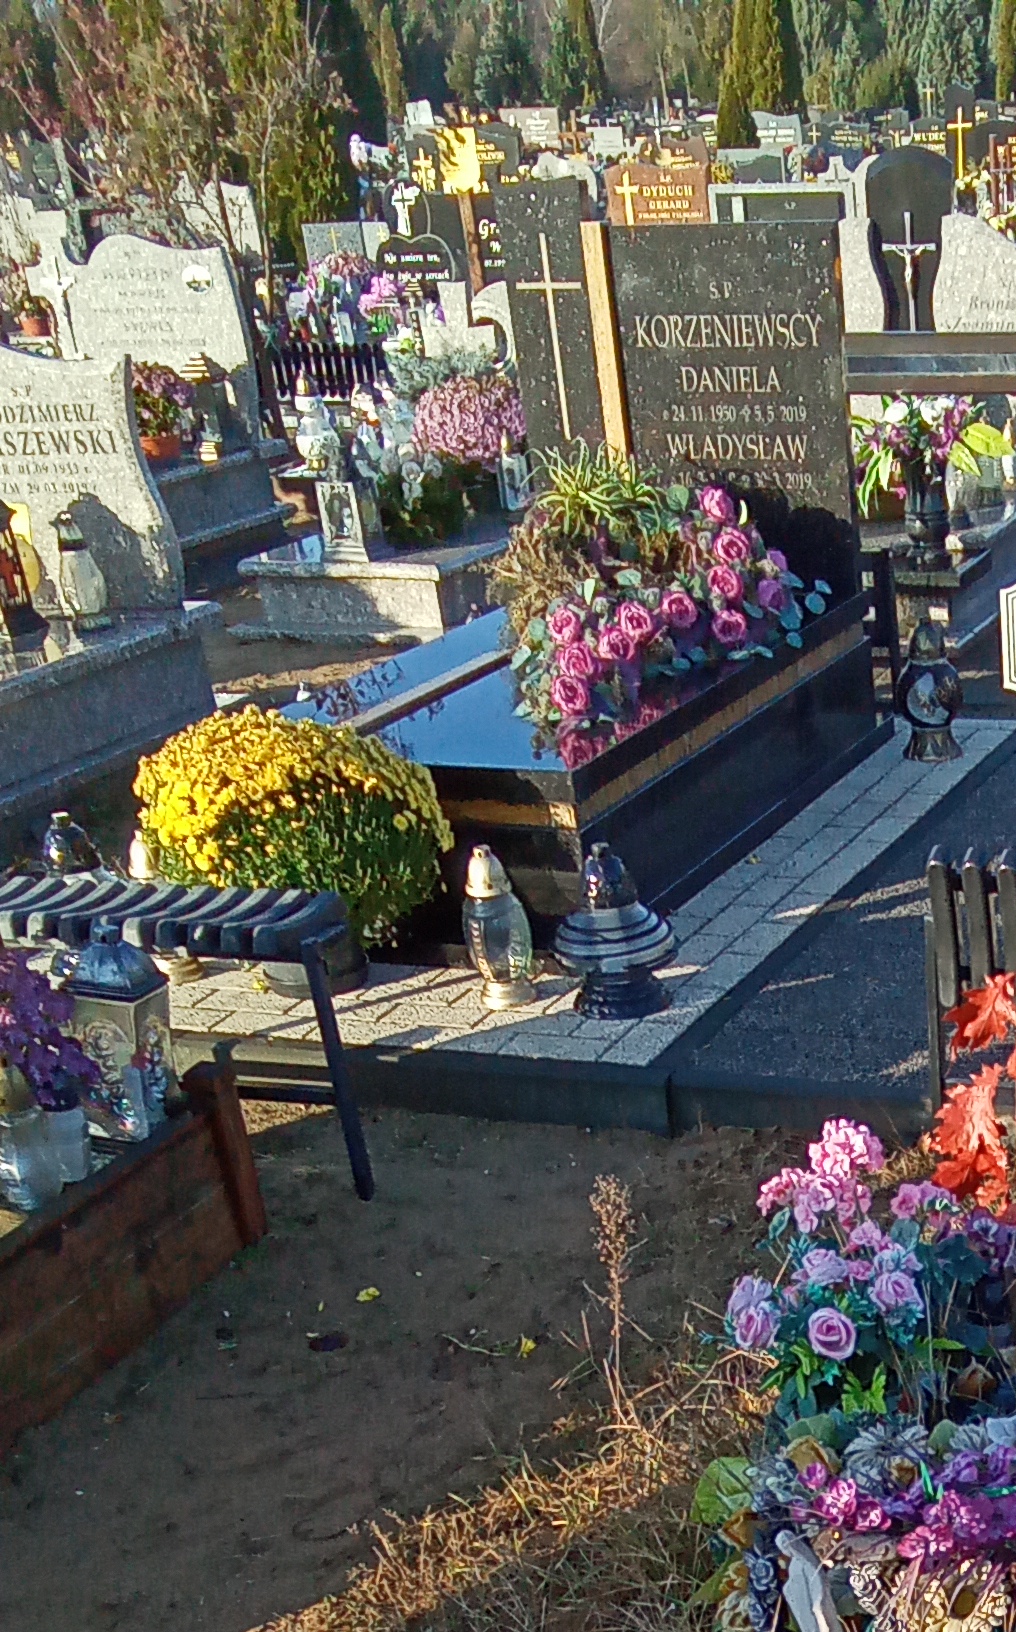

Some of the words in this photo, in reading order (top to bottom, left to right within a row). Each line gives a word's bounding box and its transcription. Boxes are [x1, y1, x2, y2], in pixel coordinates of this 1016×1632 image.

[643, 185, 693, 197] DYDUCH
[634, 312, 823, 349] KORZENIEWSCY
[680, 365, 782, 394] DANIELA
[0, 403, 100, 424] DZIMIERZ
[666, 433, 808, 461] WŁADYSŁAW
